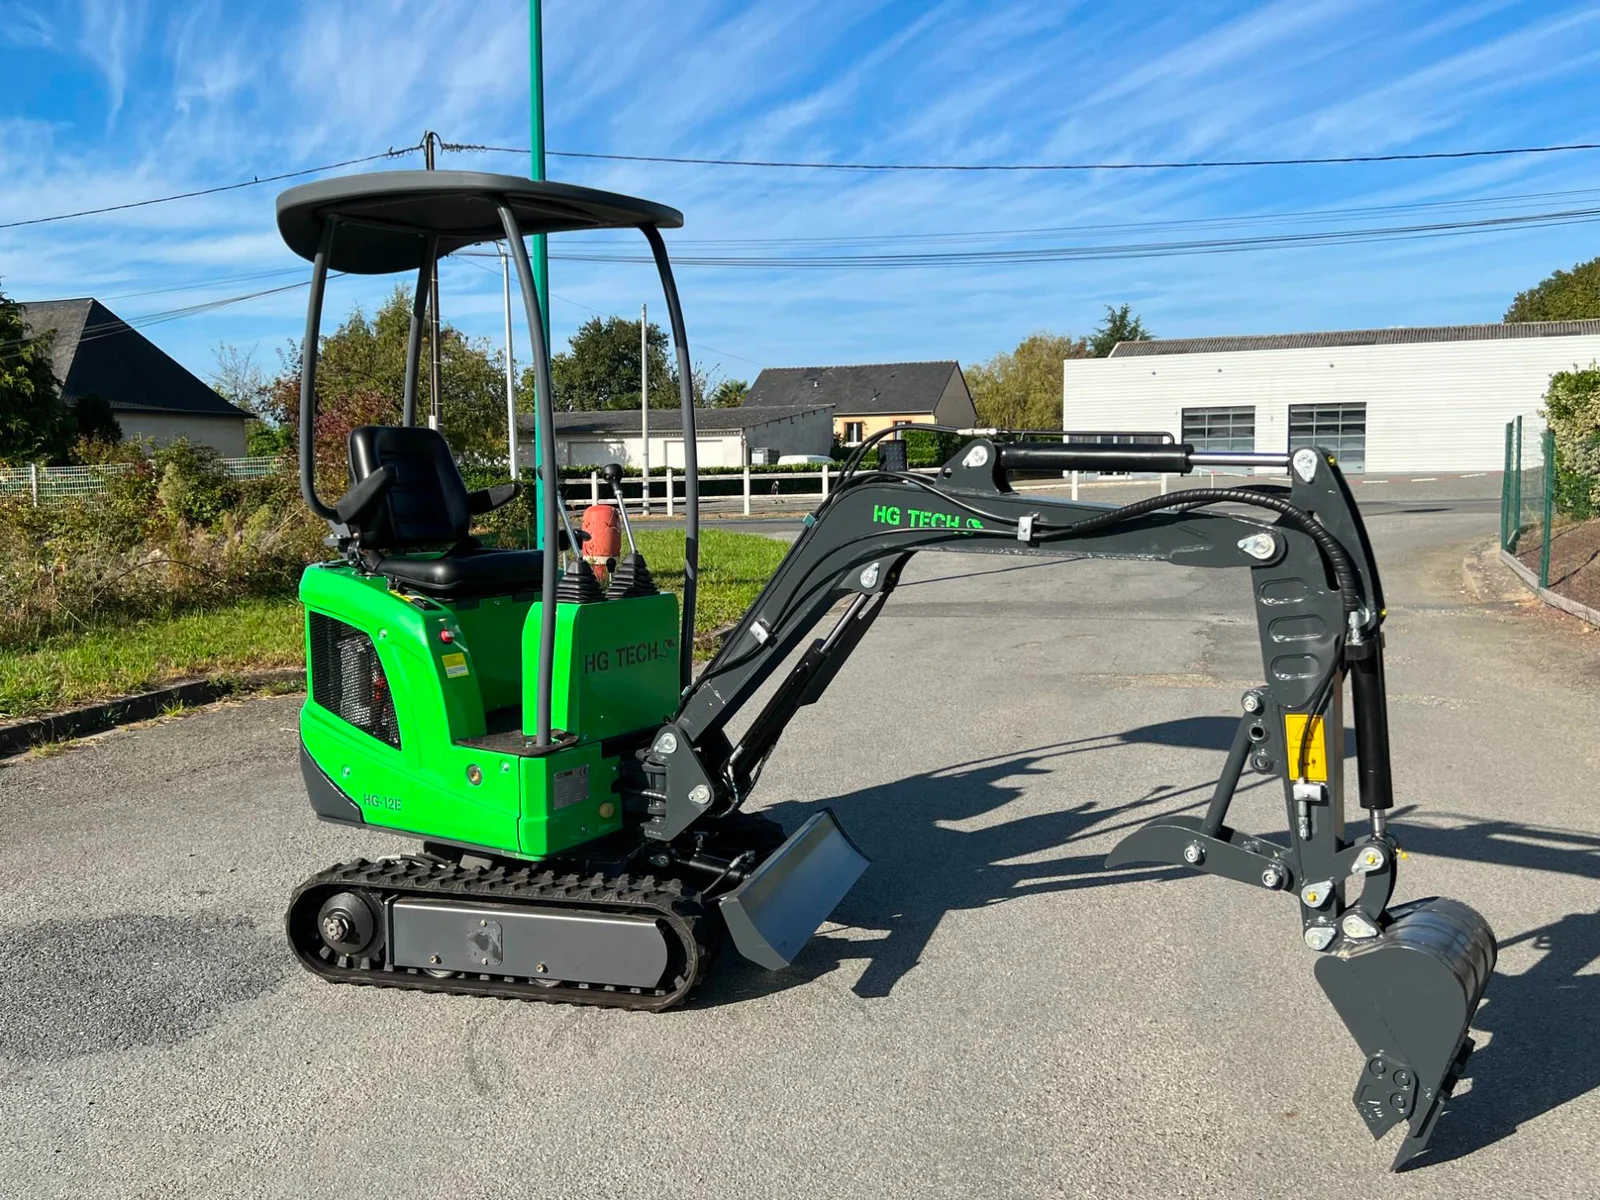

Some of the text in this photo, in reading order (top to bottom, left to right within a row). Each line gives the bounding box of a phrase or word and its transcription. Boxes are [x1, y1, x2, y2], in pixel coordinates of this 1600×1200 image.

[873, 504, 960, 528] HG TECH
[584, 641, 659, 674] HG TECH
[363, 793, 402, 812] HG-12E
